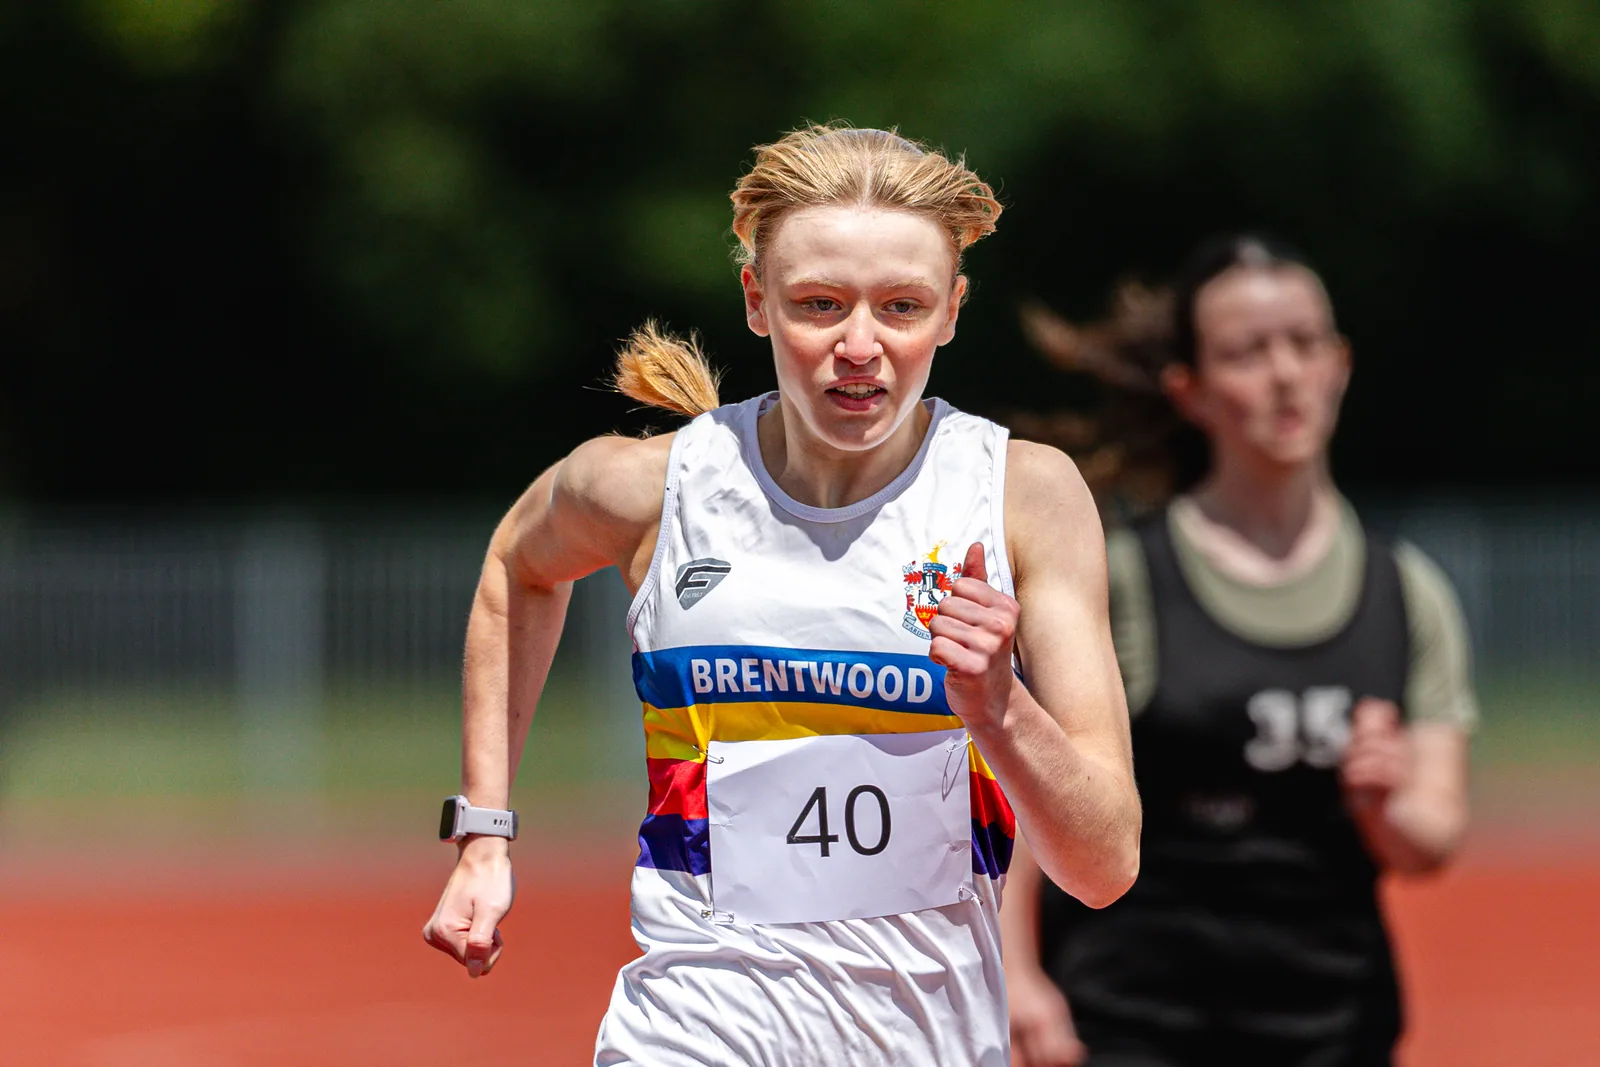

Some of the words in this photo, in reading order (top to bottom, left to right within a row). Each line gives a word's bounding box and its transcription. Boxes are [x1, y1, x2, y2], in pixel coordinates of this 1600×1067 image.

[691, 658, 933, 704] BRENTWOOD
[1245, 686, 1352, 771] 35
[786, 784, 892, 858] 40
